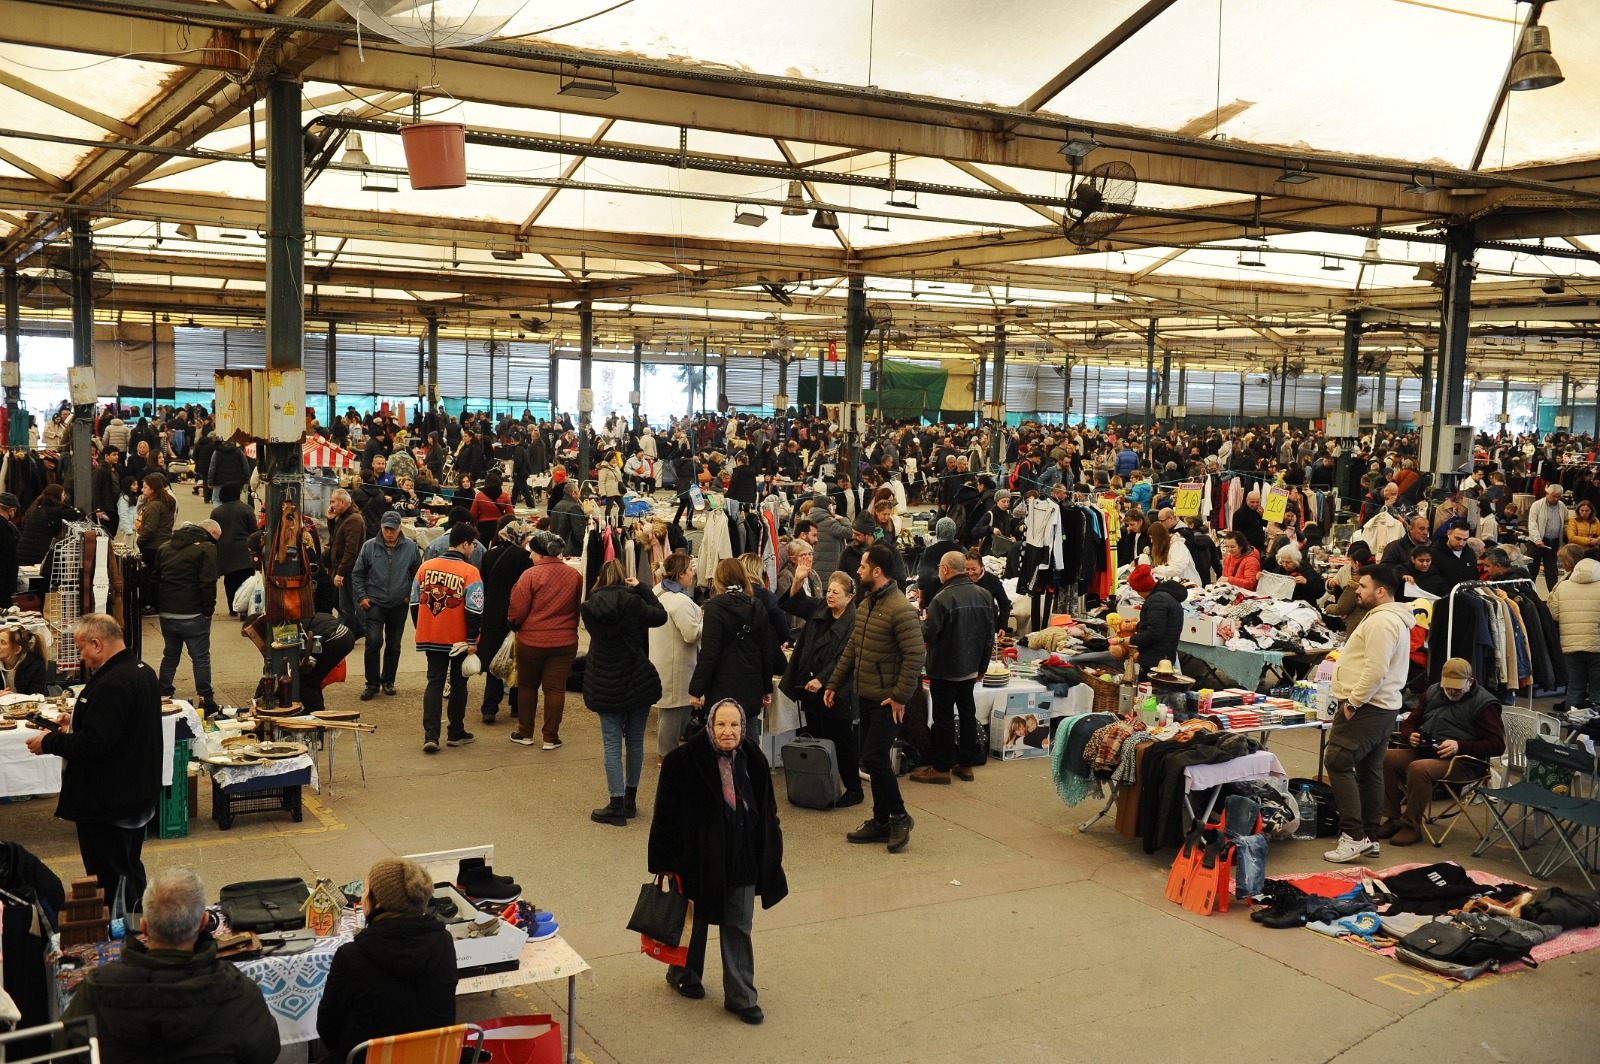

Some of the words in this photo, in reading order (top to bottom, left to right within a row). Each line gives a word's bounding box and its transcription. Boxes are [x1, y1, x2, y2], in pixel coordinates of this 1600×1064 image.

[1178, 491, 1199, 510] 10
[1267, 496, 1285, 513] 10
[419, 569, 465, 599] LEGENDS
